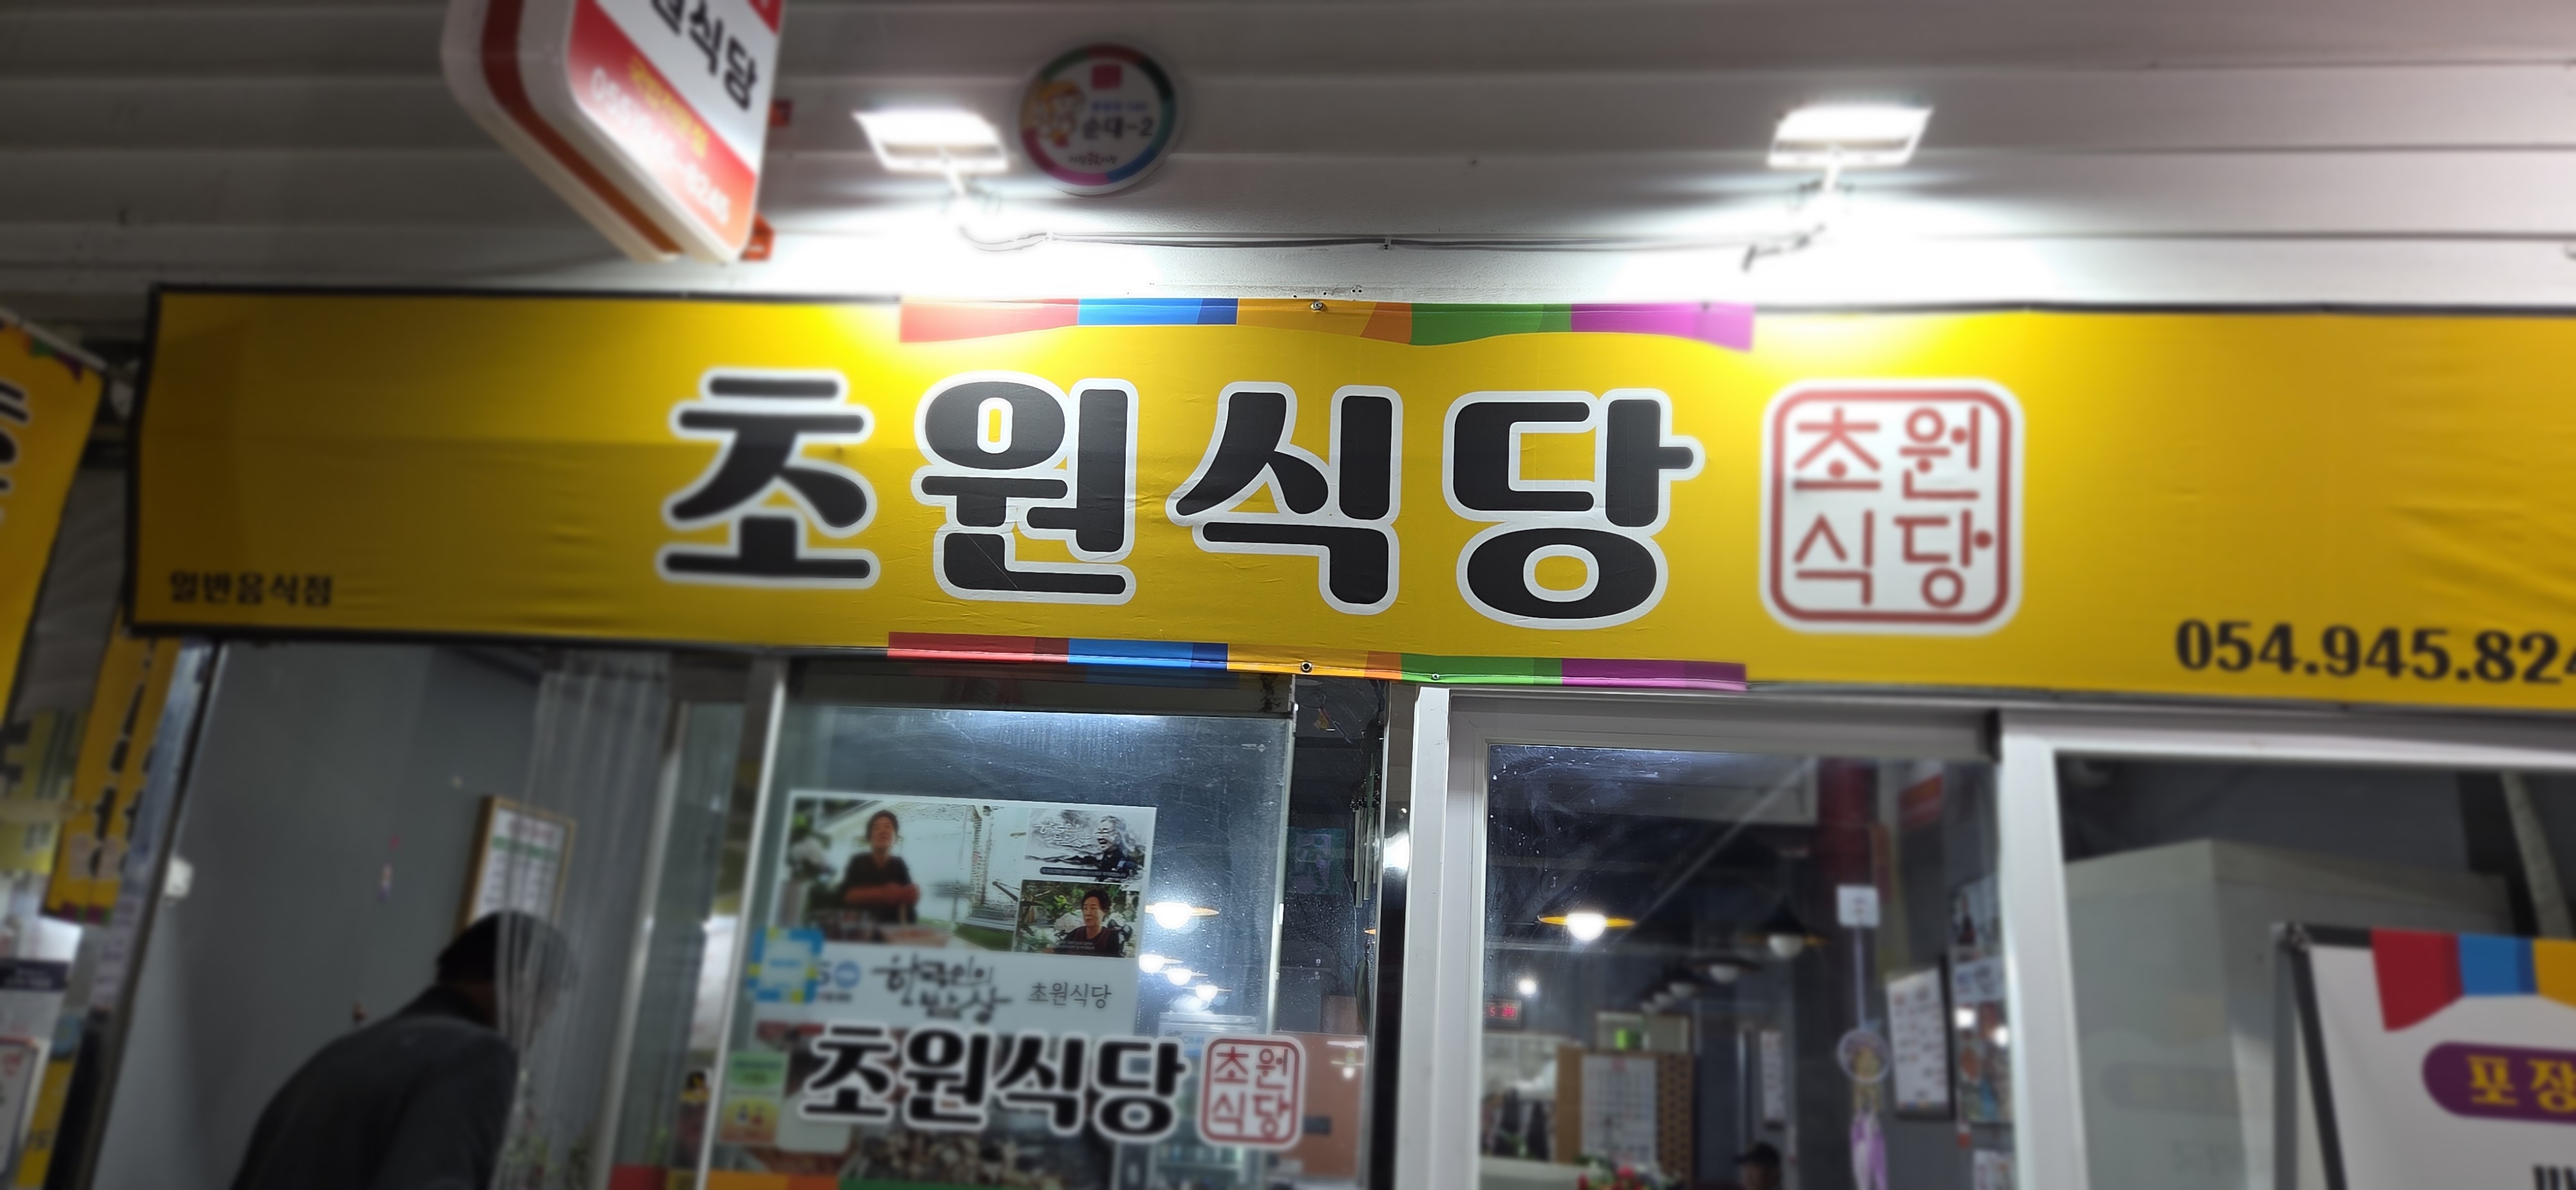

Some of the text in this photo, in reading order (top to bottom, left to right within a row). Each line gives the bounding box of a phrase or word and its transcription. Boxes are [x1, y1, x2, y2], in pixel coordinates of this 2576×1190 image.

[1793, 405, 1981, 501] 초원
[661, 375, 1695, 621] 초원식당
[170, 570, 334, 607] 일반음식점
[1794, 508, 1993, 610] 식당
[1027, 981, 1112, 1010] 초원식당
[803, 1026, 1187, 1137] 초원식당
[1213, 1046, 1289, 1090] 초원
[2466, 1054, 2576, 1113] 포장
[1213, 1091, 1291, 1139] 식당
